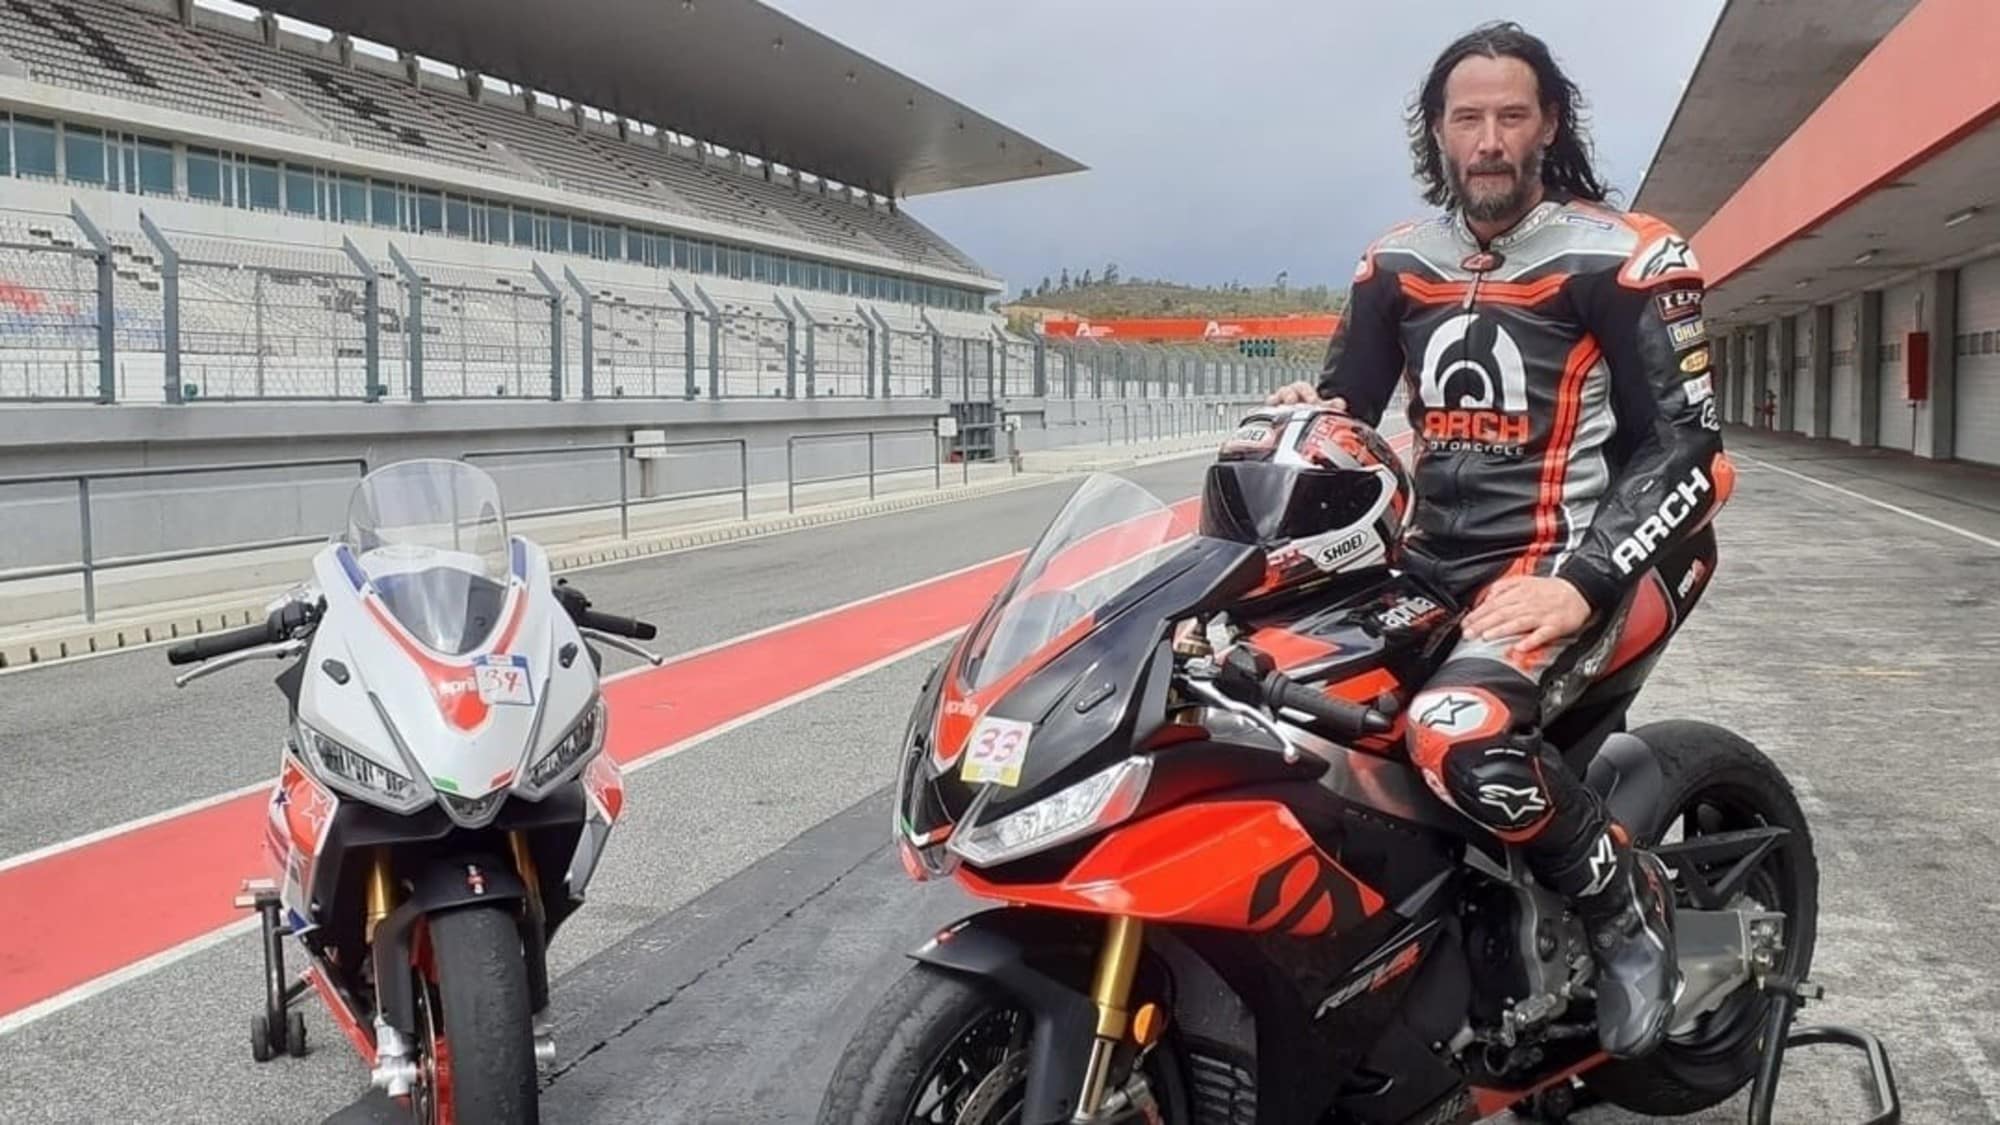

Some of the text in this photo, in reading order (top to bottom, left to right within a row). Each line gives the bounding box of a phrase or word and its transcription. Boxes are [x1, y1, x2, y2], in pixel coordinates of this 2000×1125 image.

[1423, 410, 1529, 443] ARCH
[1430, 440, 1526, 456] OTORCYCLE
[1611, 466, 1711, 575] ARCH
[1323, 534, 1362, 563] SHOEI
[974, 727, 1023, 763] 33
